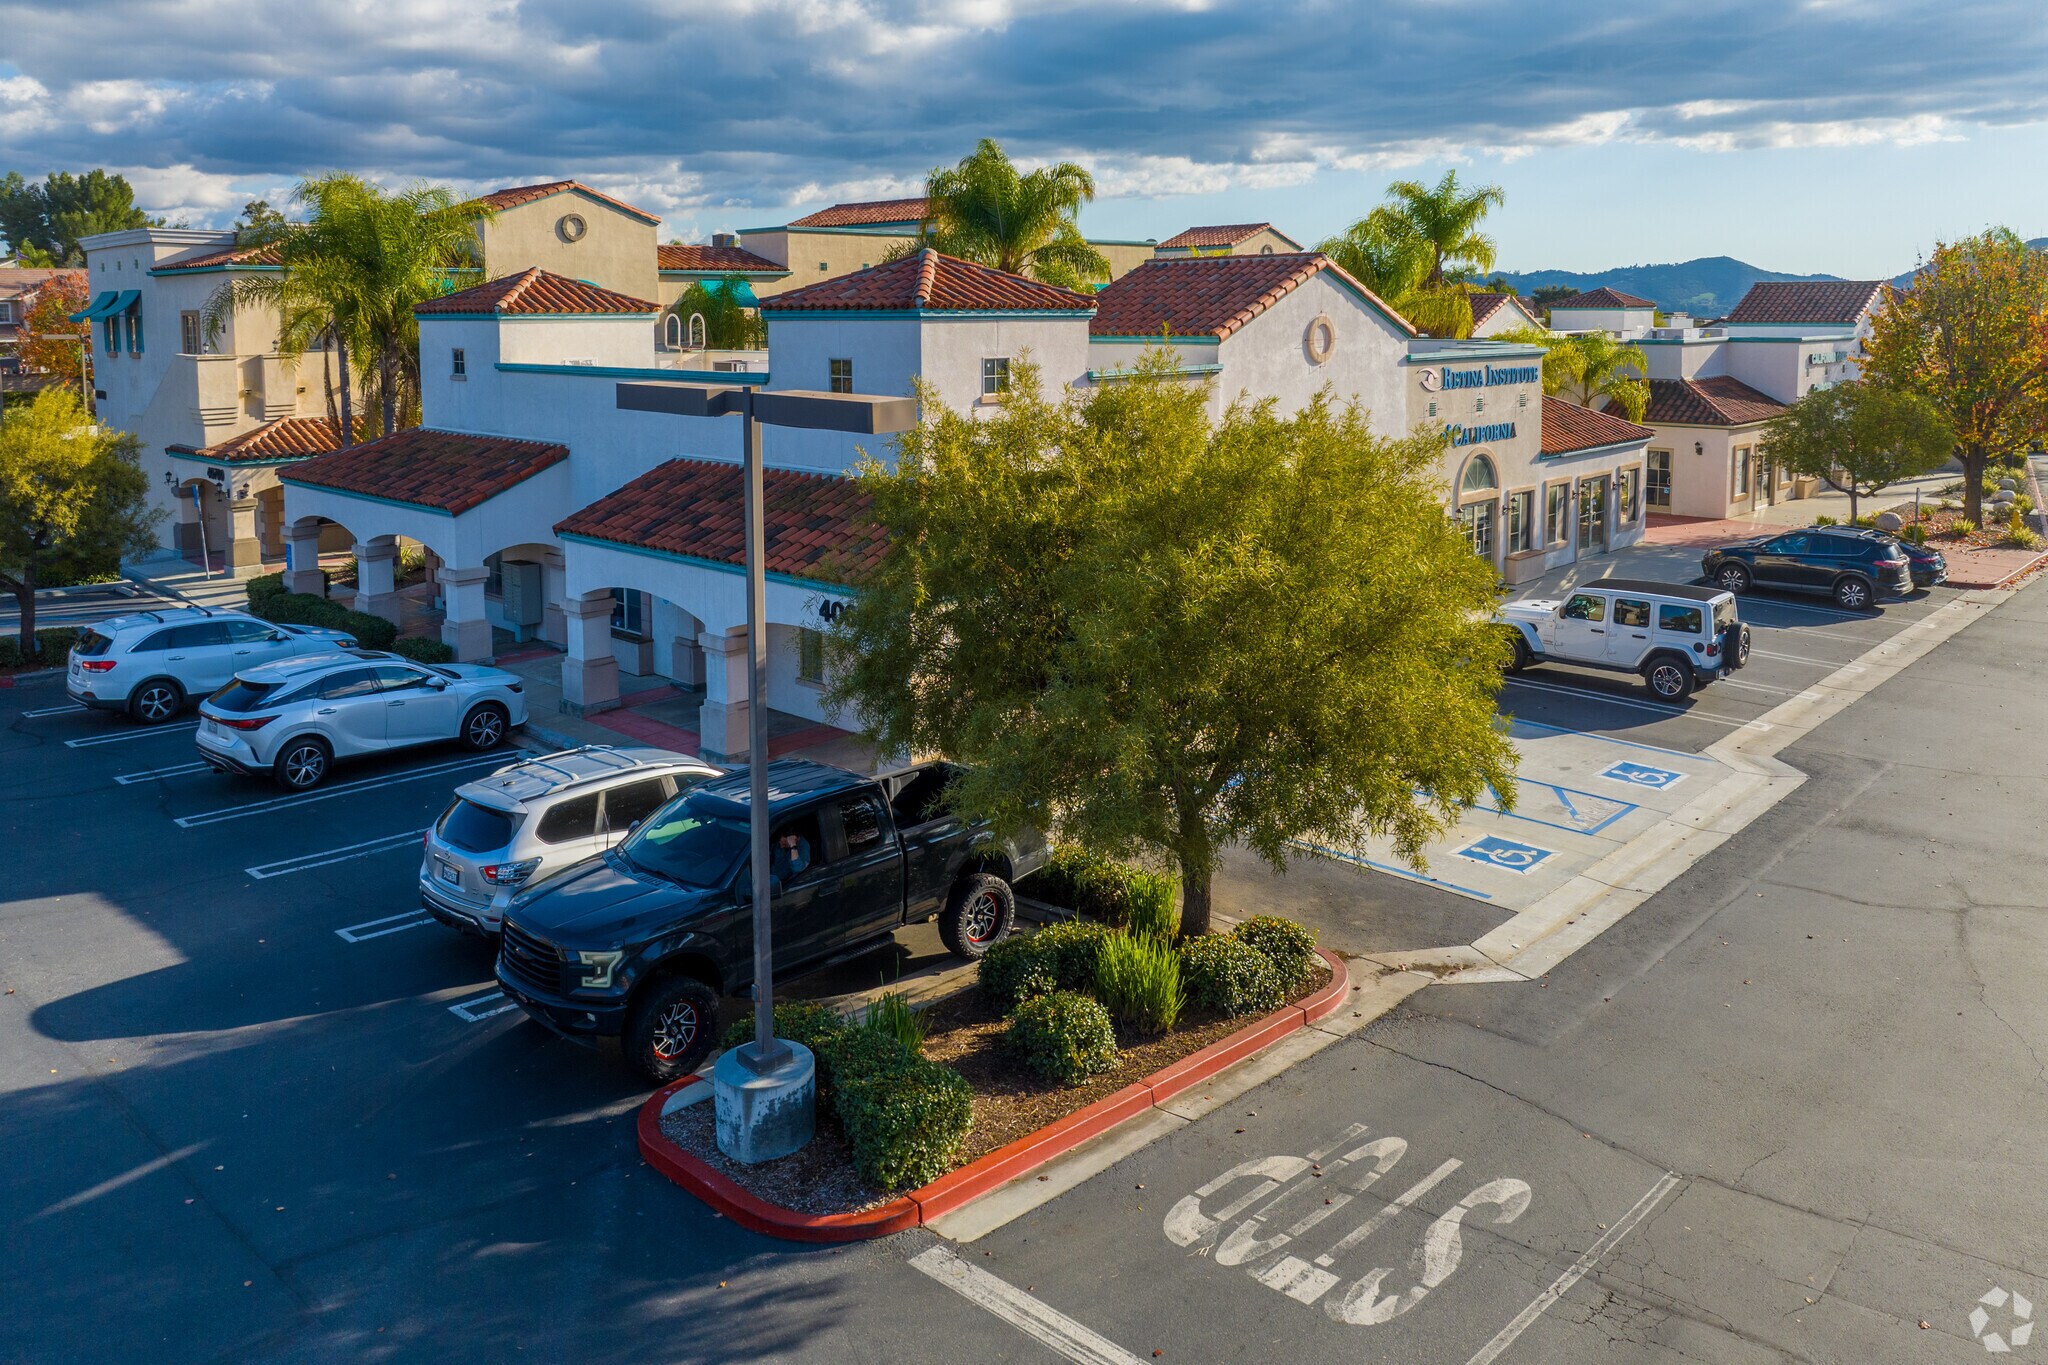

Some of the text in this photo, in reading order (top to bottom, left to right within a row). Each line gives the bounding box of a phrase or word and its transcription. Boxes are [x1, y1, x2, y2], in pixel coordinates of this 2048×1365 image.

[1441, 363, 1539, 390] RETINA INSTITUTE
[1453, 421, 1517, 447] CALIFORNIA
[1163, 1122, 1532, 1326] STOP
